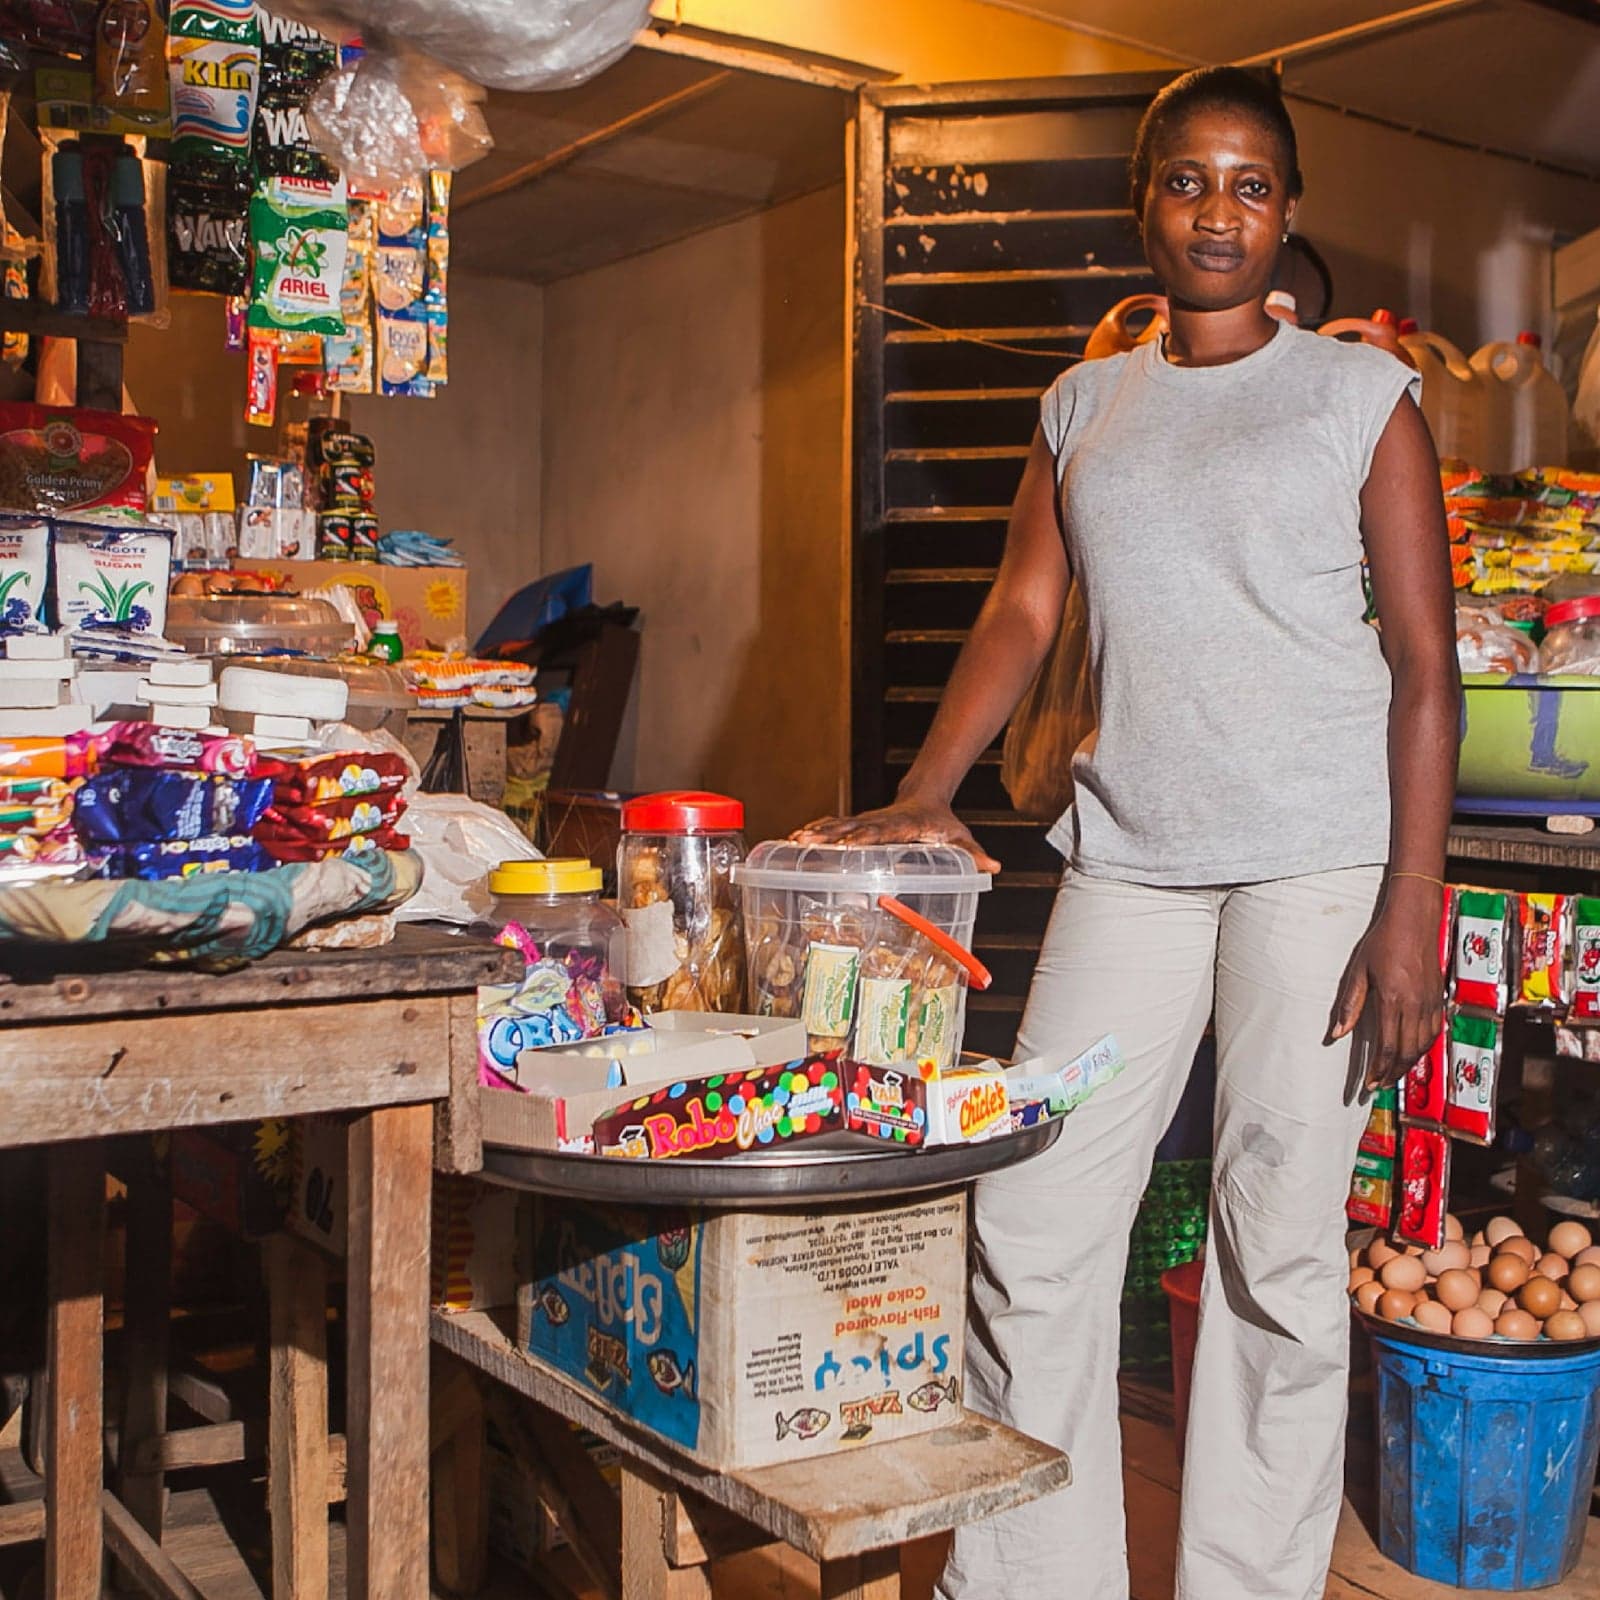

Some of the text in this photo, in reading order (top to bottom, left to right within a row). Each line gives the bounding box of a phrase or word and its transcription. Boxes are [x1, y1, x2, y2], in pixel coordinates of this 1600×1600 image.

[182, 58, 251, 90] Klin
[259, 107, 311, 146] WA
[175, 213, 244, 251] WAW
[280, 277, 330, 298] ARIEL
[26, 474, 103, 490] Golden Penny
[49, 488, 80, 500] wist
[94, 559, 142, 569] SUGAR
[644, 1098, 737, 1159] Robo
[737, 1101, 784, 1150] Choc
[923, 1229, 938, 1239] Box
[838, 1263, 872, 1277] FOODS
[874, 1259, 899, 1271] YALE
[835, 1279, 859, 1290] Nigeria
[868, 1275, 887, 1286] Made
[887, 1286, 927, 1305] Cake
[835, 1305, 941, 1336] Fish-Flavoured
